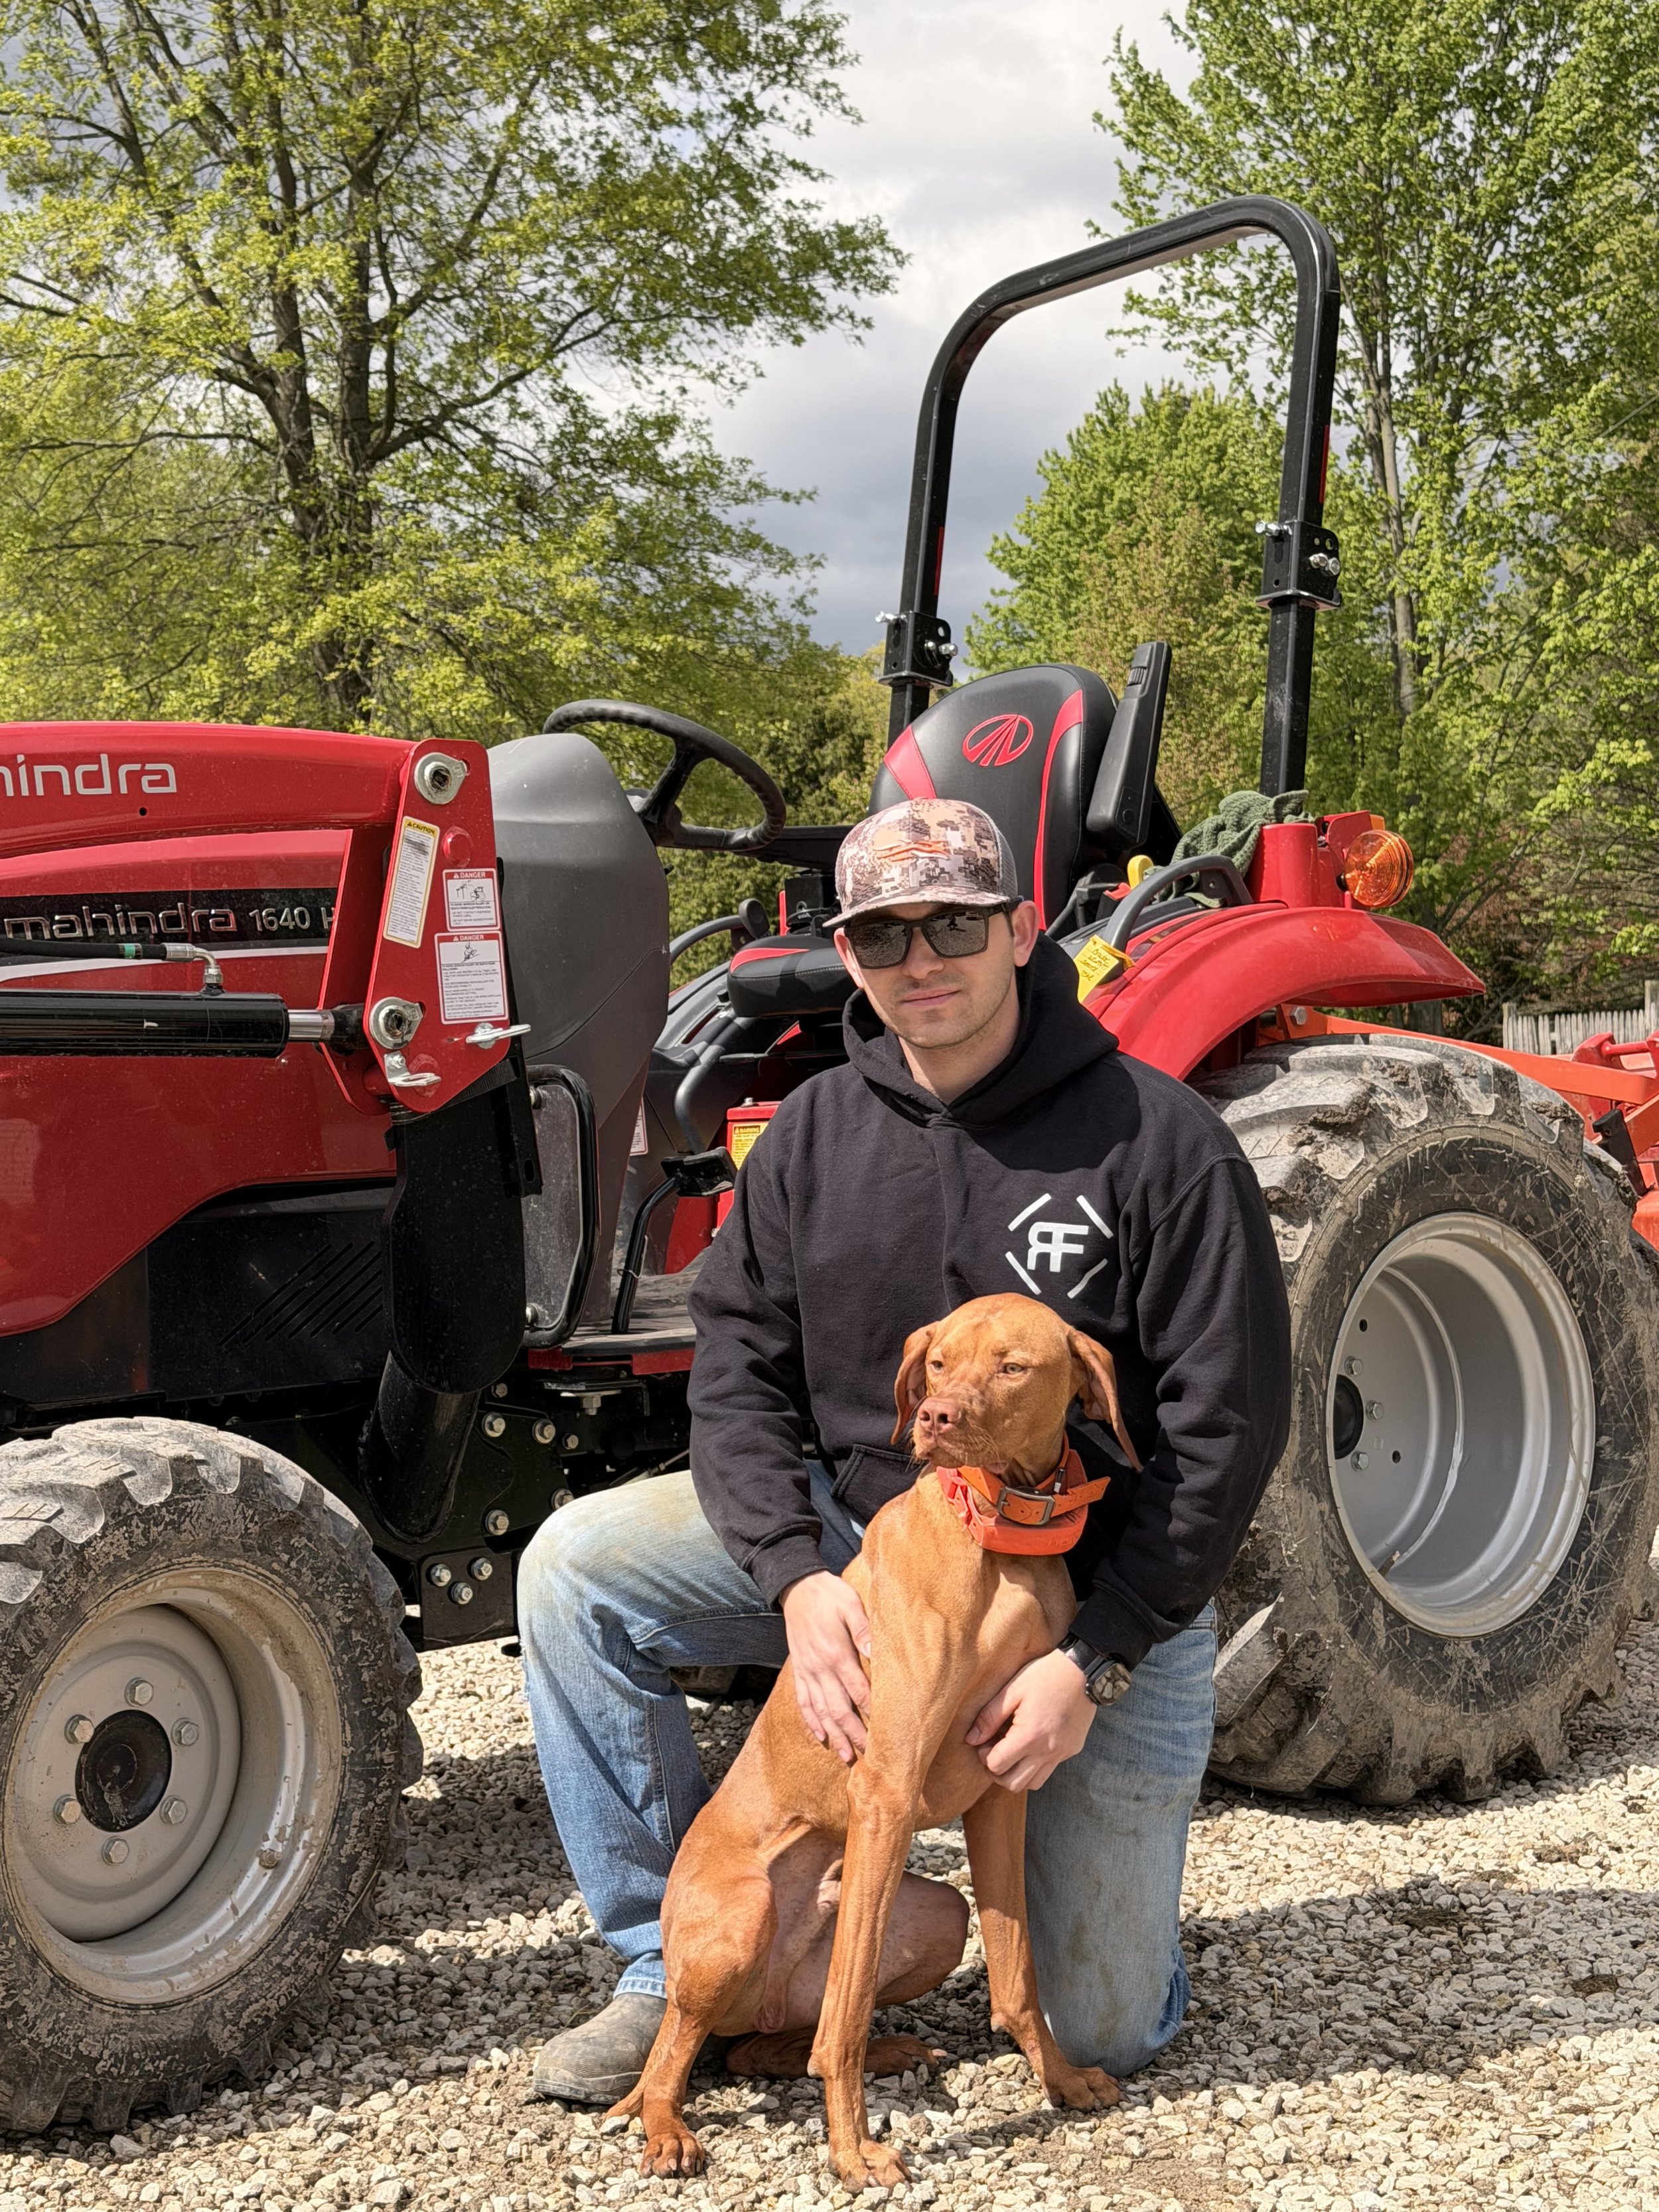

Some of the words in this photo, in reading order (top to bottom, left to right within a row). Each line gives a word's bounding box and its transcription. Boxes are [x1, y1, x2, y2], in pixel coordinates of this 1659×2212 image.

[412, 823, 435, 835] CAUTION
[3, 903, 237, 940] mahindra
[249, 907, 310, 930] 1640
